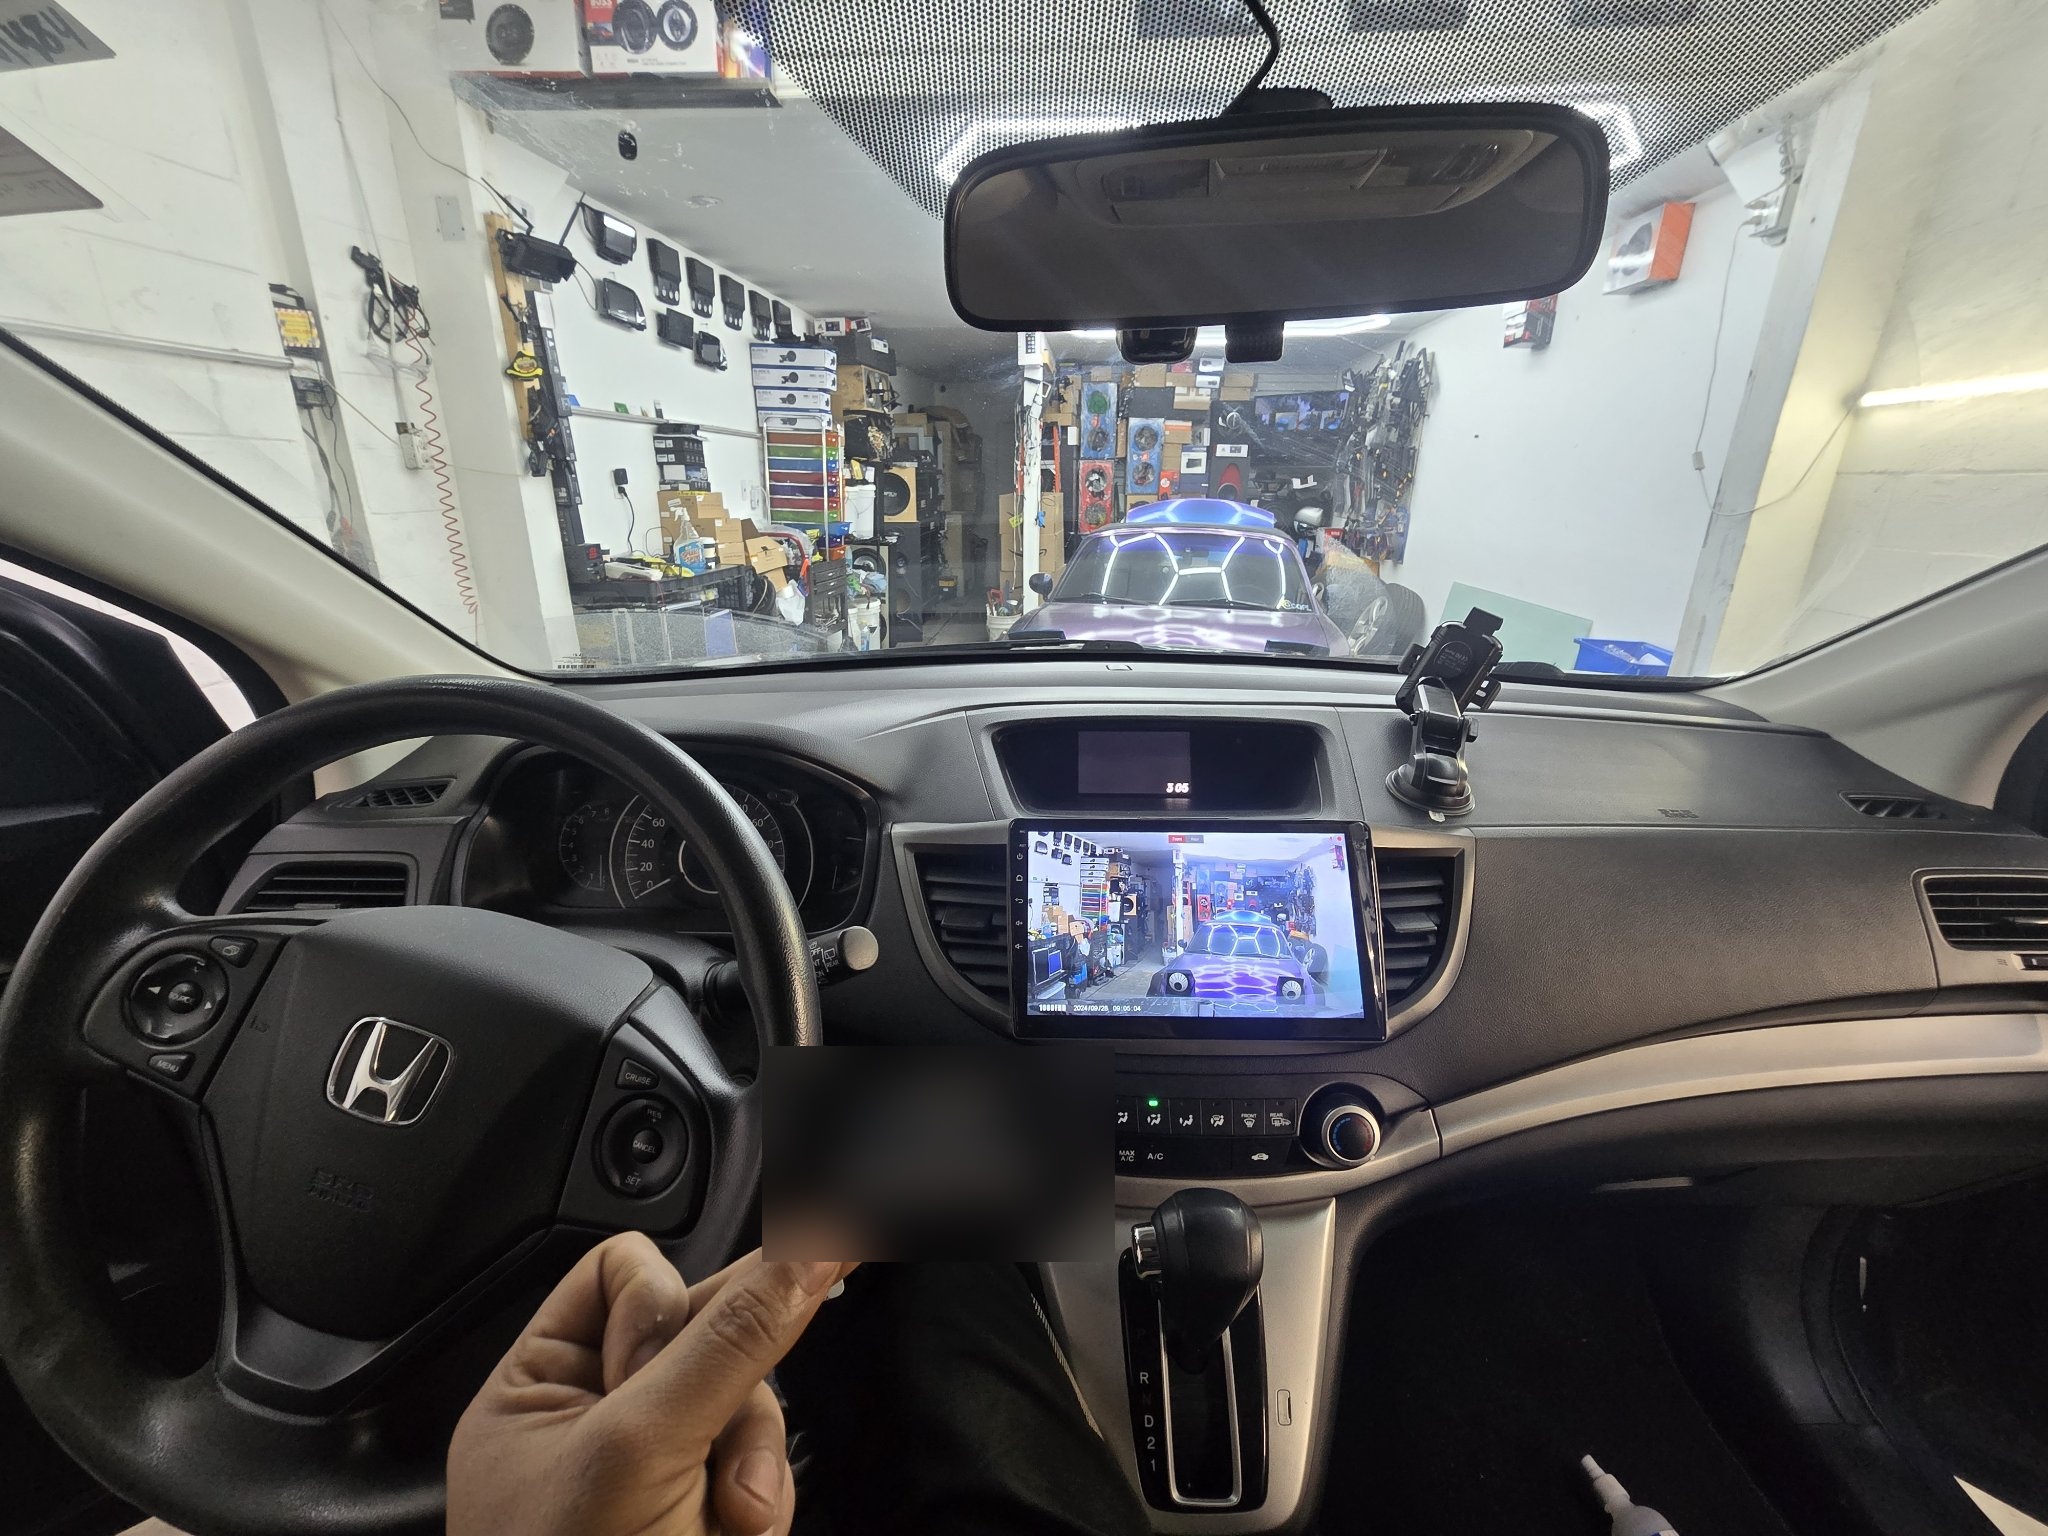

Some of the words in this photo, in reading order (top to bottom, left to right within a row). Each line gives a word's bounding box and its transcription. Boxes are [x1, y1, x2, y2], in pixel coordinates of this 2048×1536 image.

[652, 818, 665, 827] 60
[641, 838, 655, 848] 40
[640, 862, 653, 872] 20
[646, 880, 654, 888] 0
[157, 1060, 179, 1073] MENU
[625, 1072, 651, 1085] CRUISE
[632, 1140, 656, 1153] CANCEL
[1147, 1152, 1164, 1160] A/C
[625, 1174, 641, 1186] SET
[1139, 1371, 1149, 1384] R
[1144, 1414, 1154, 1428] D
[1146, 1436, 1156, 1450] 2
[1150, 1460, 1156, 1472] 1
